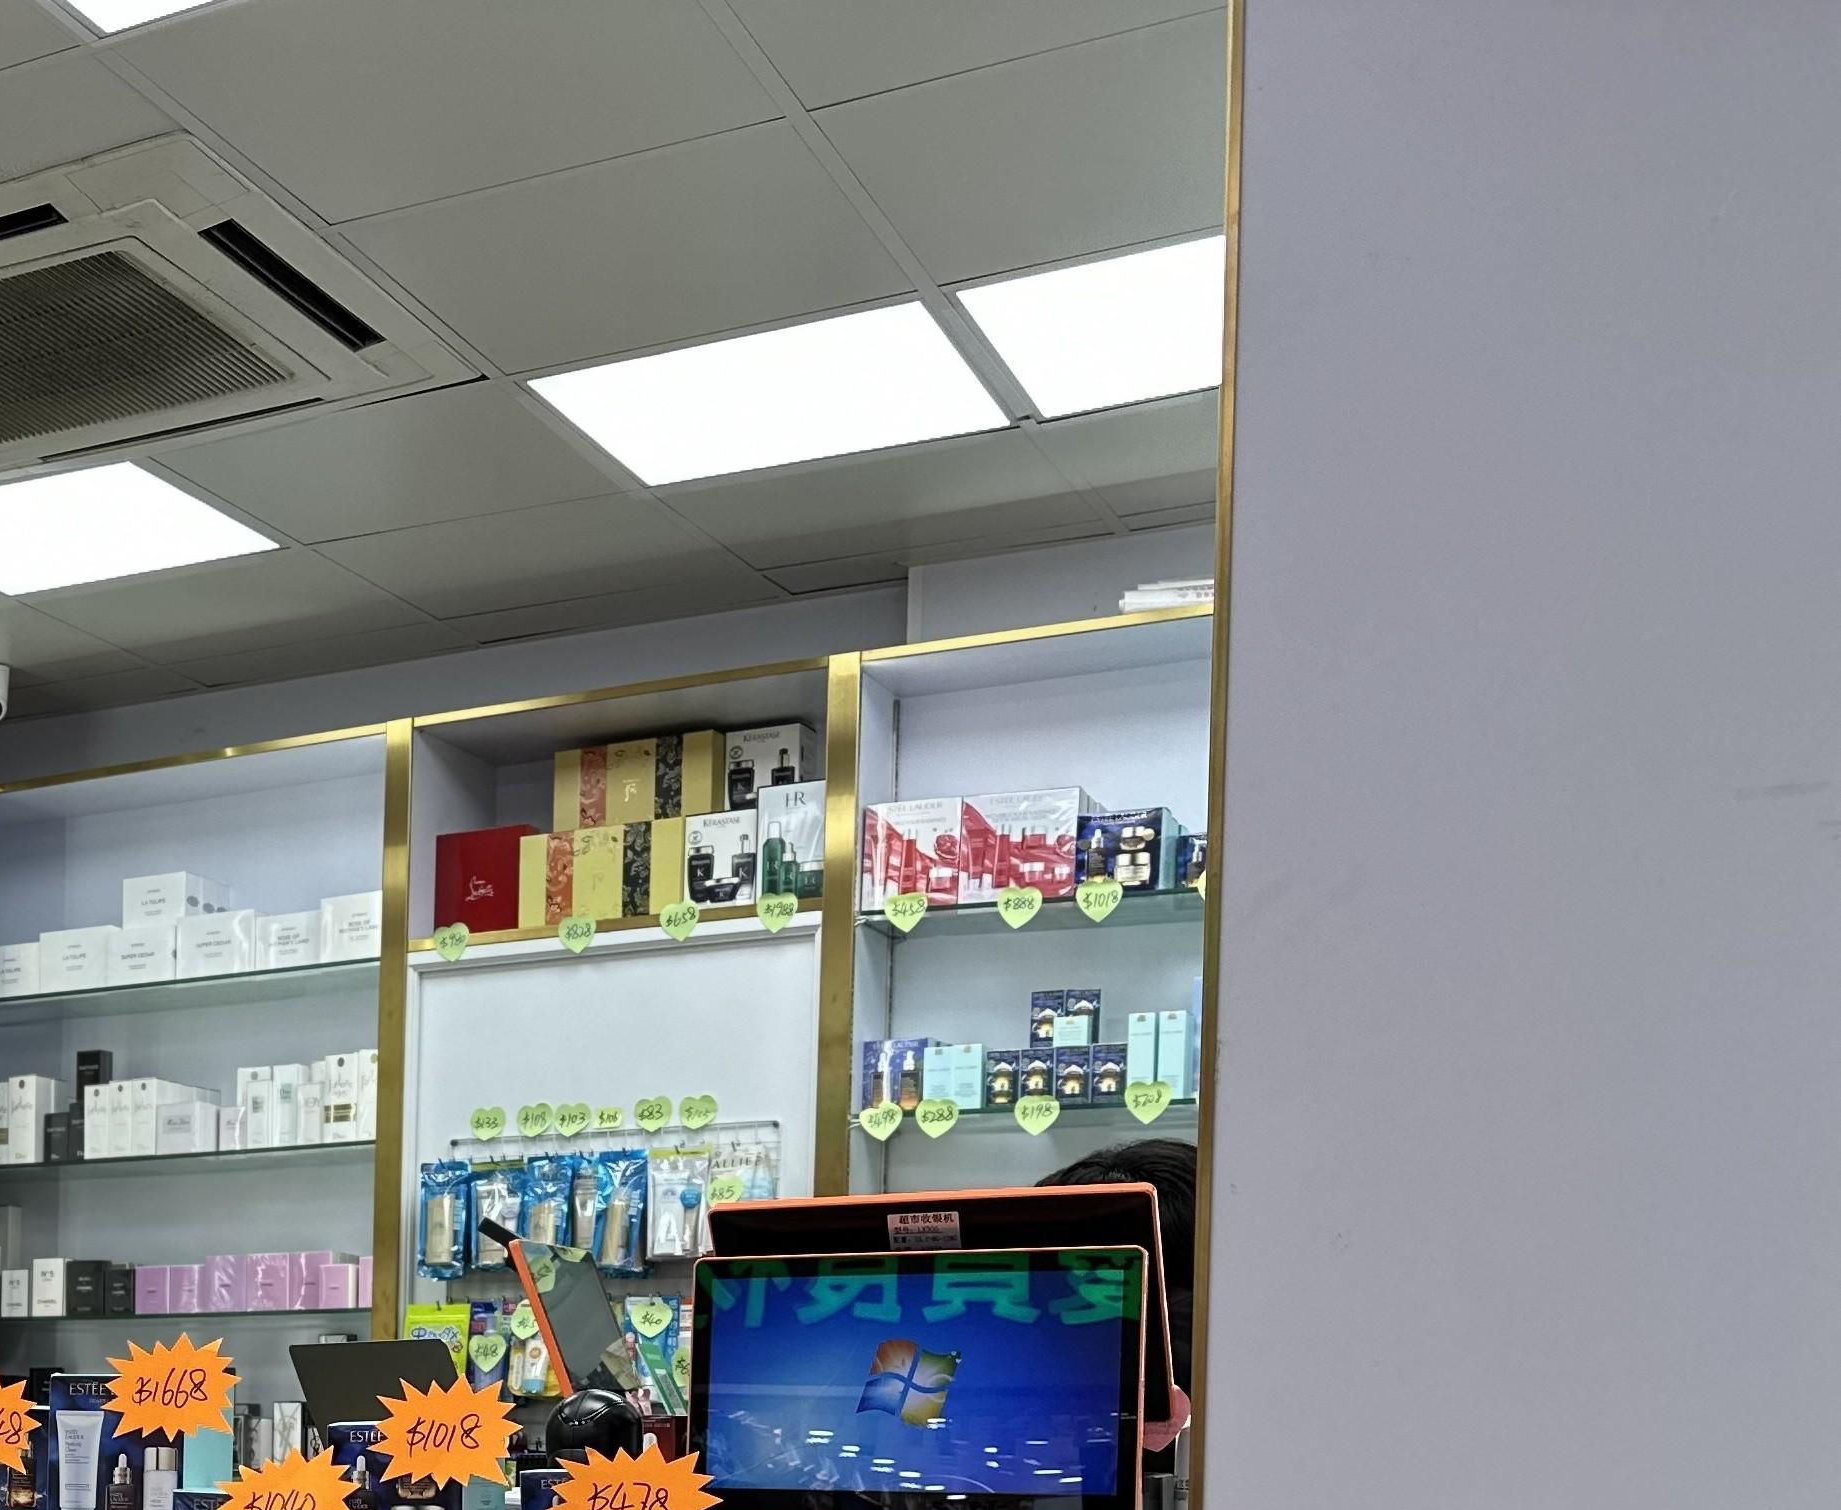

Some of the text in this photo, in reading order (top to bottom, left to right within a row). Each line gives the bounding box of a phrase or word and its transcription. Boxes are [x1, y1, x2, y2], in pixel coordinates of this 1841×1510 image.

[1082, 891, 1121, 909] $1018
[1021, 1101, 1053, 1120] $198
[132, 1368, 209, 1409] $1668
[406, 1414, 483, 1451] $1018
